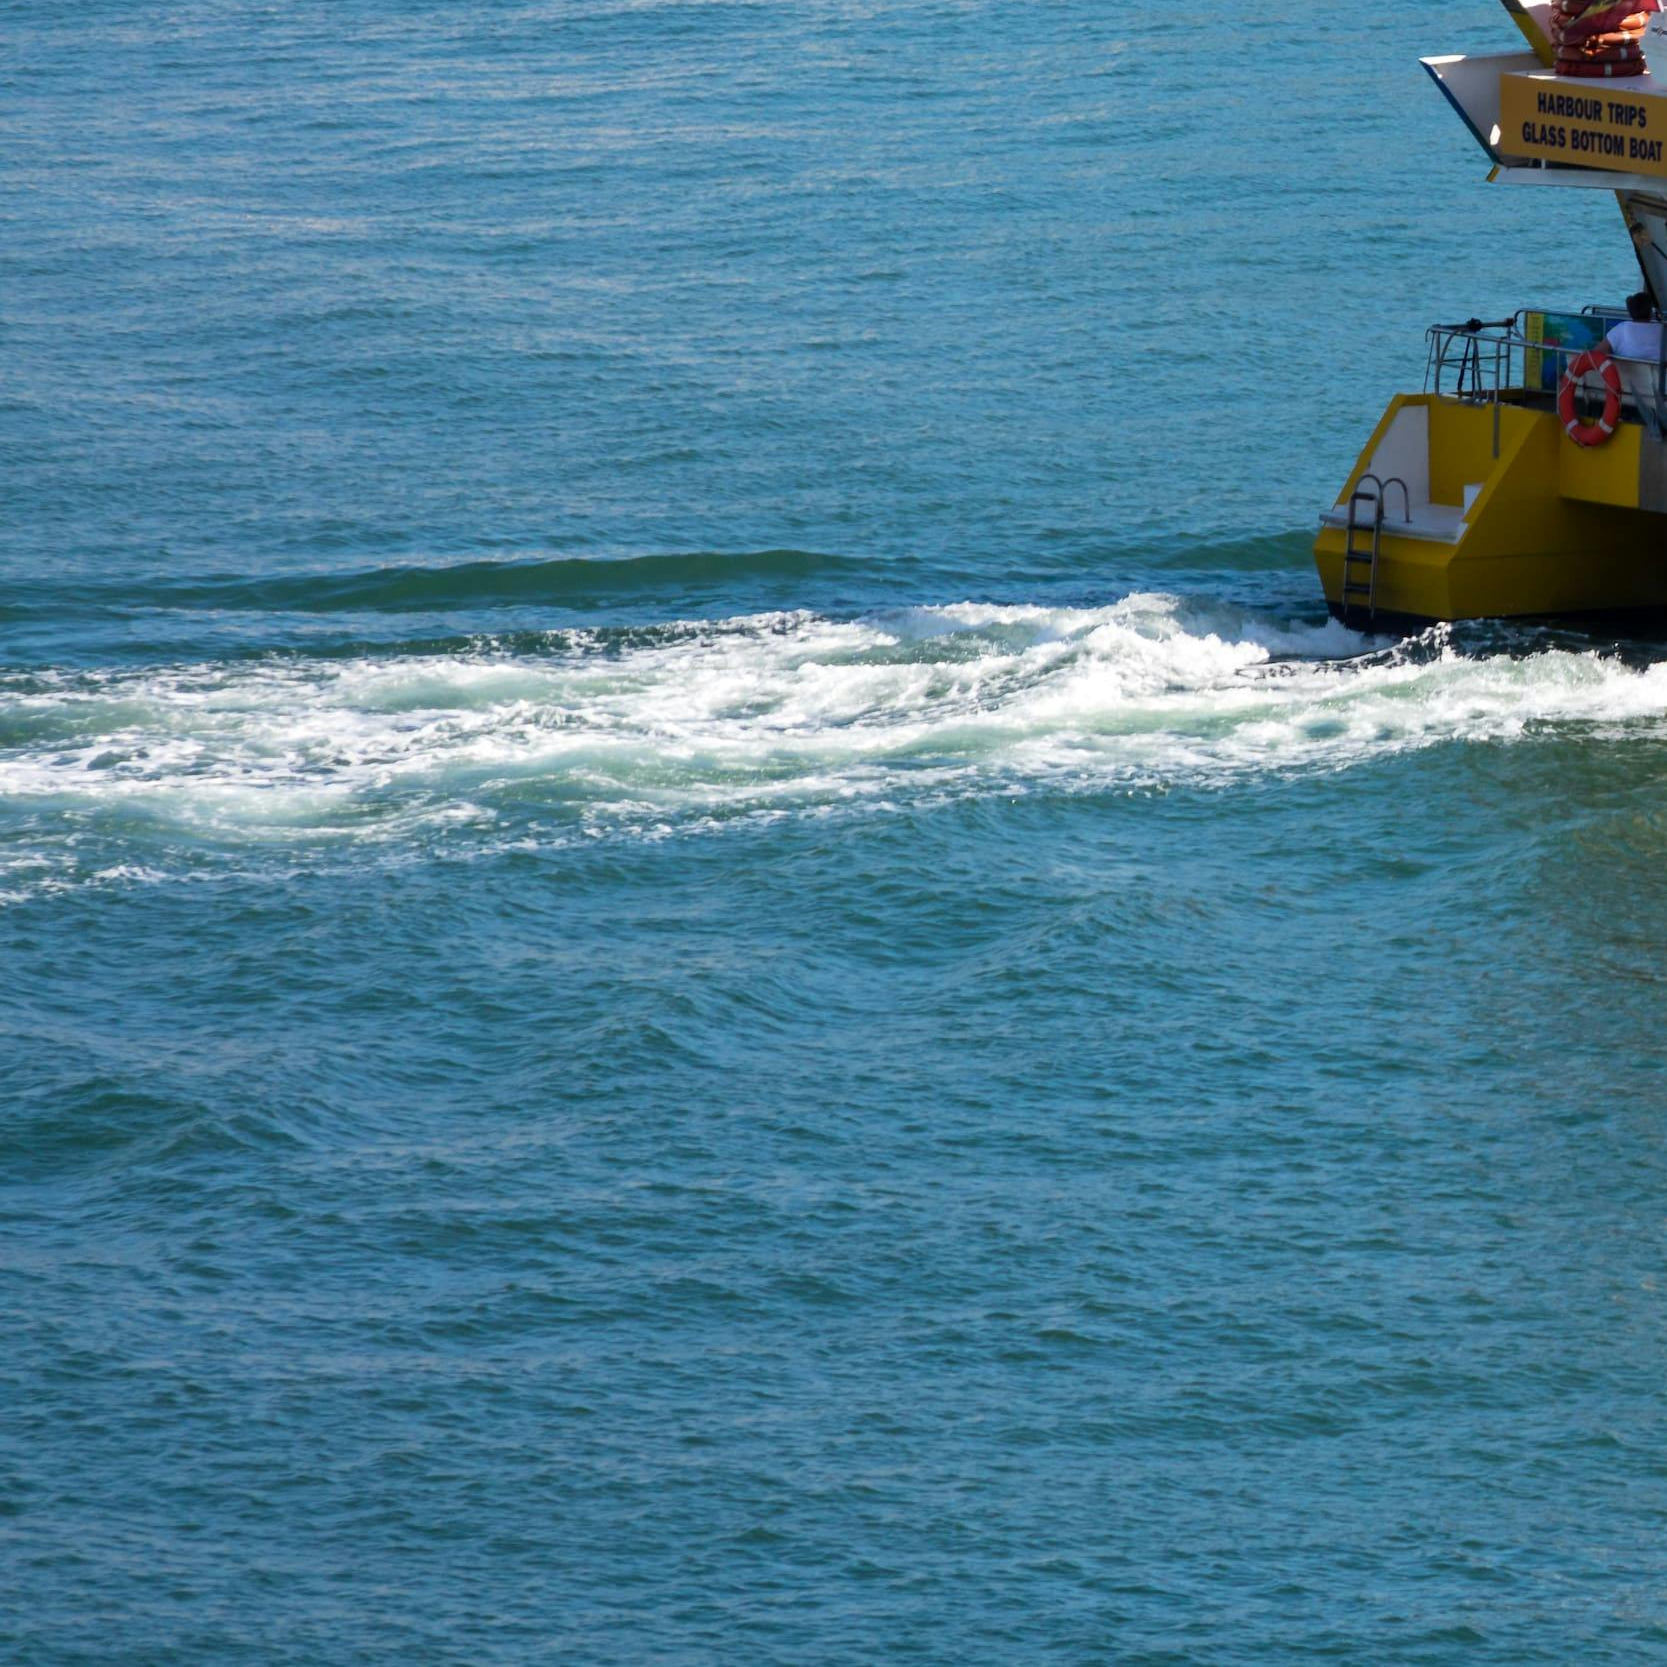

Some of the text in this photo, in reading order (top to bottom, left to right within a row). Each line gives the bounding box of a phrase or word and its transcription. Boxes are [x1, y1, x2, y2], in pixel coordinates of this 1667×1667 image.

[1537, 91, 1647, 129] HARBOUR TRIPS
[1522, 121, 1663, 163] GLASS BOTTOM BOAT
